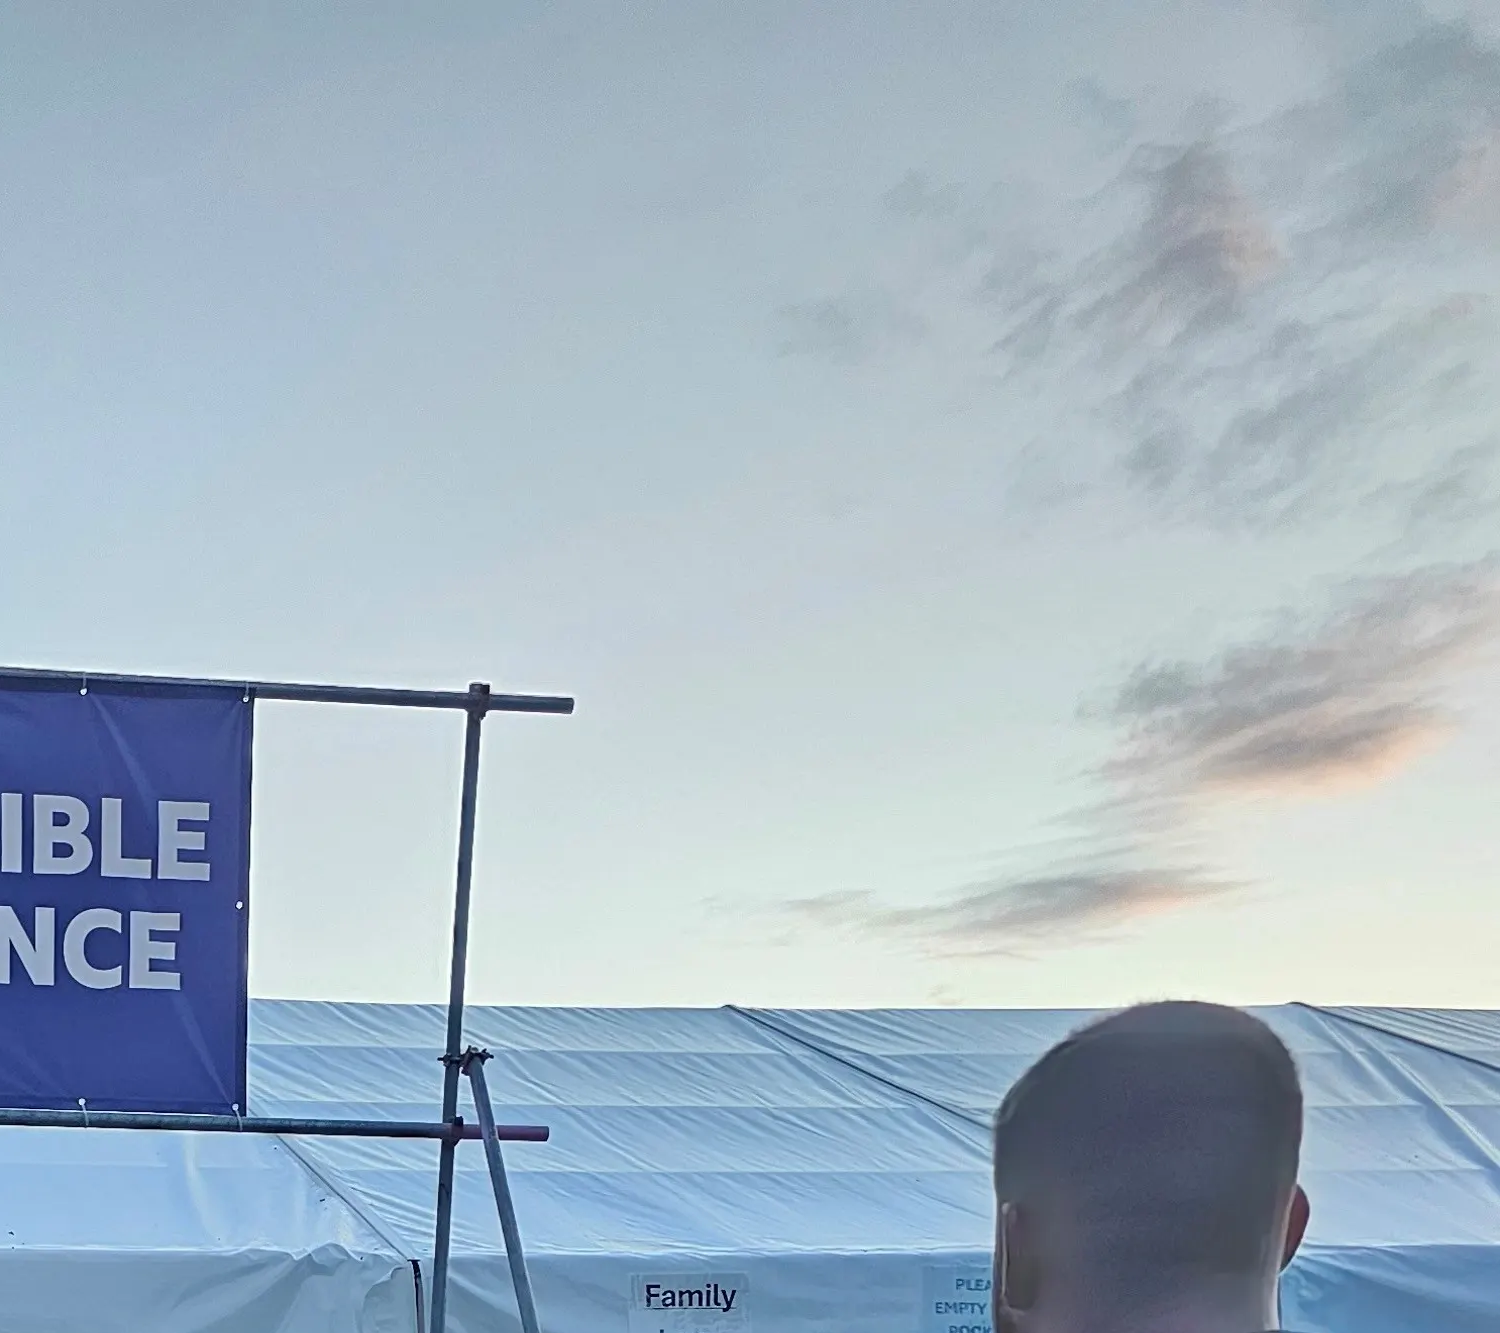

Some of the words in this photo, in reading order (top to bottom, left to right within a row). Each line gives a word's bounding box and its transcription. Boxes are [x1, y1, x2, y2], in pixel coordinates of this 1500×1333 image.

[955, 1278, 992, 1291] PLEA
[645, 1283, 737, 1312] Family
[935, 1301, 988, 1315] EMPTY
